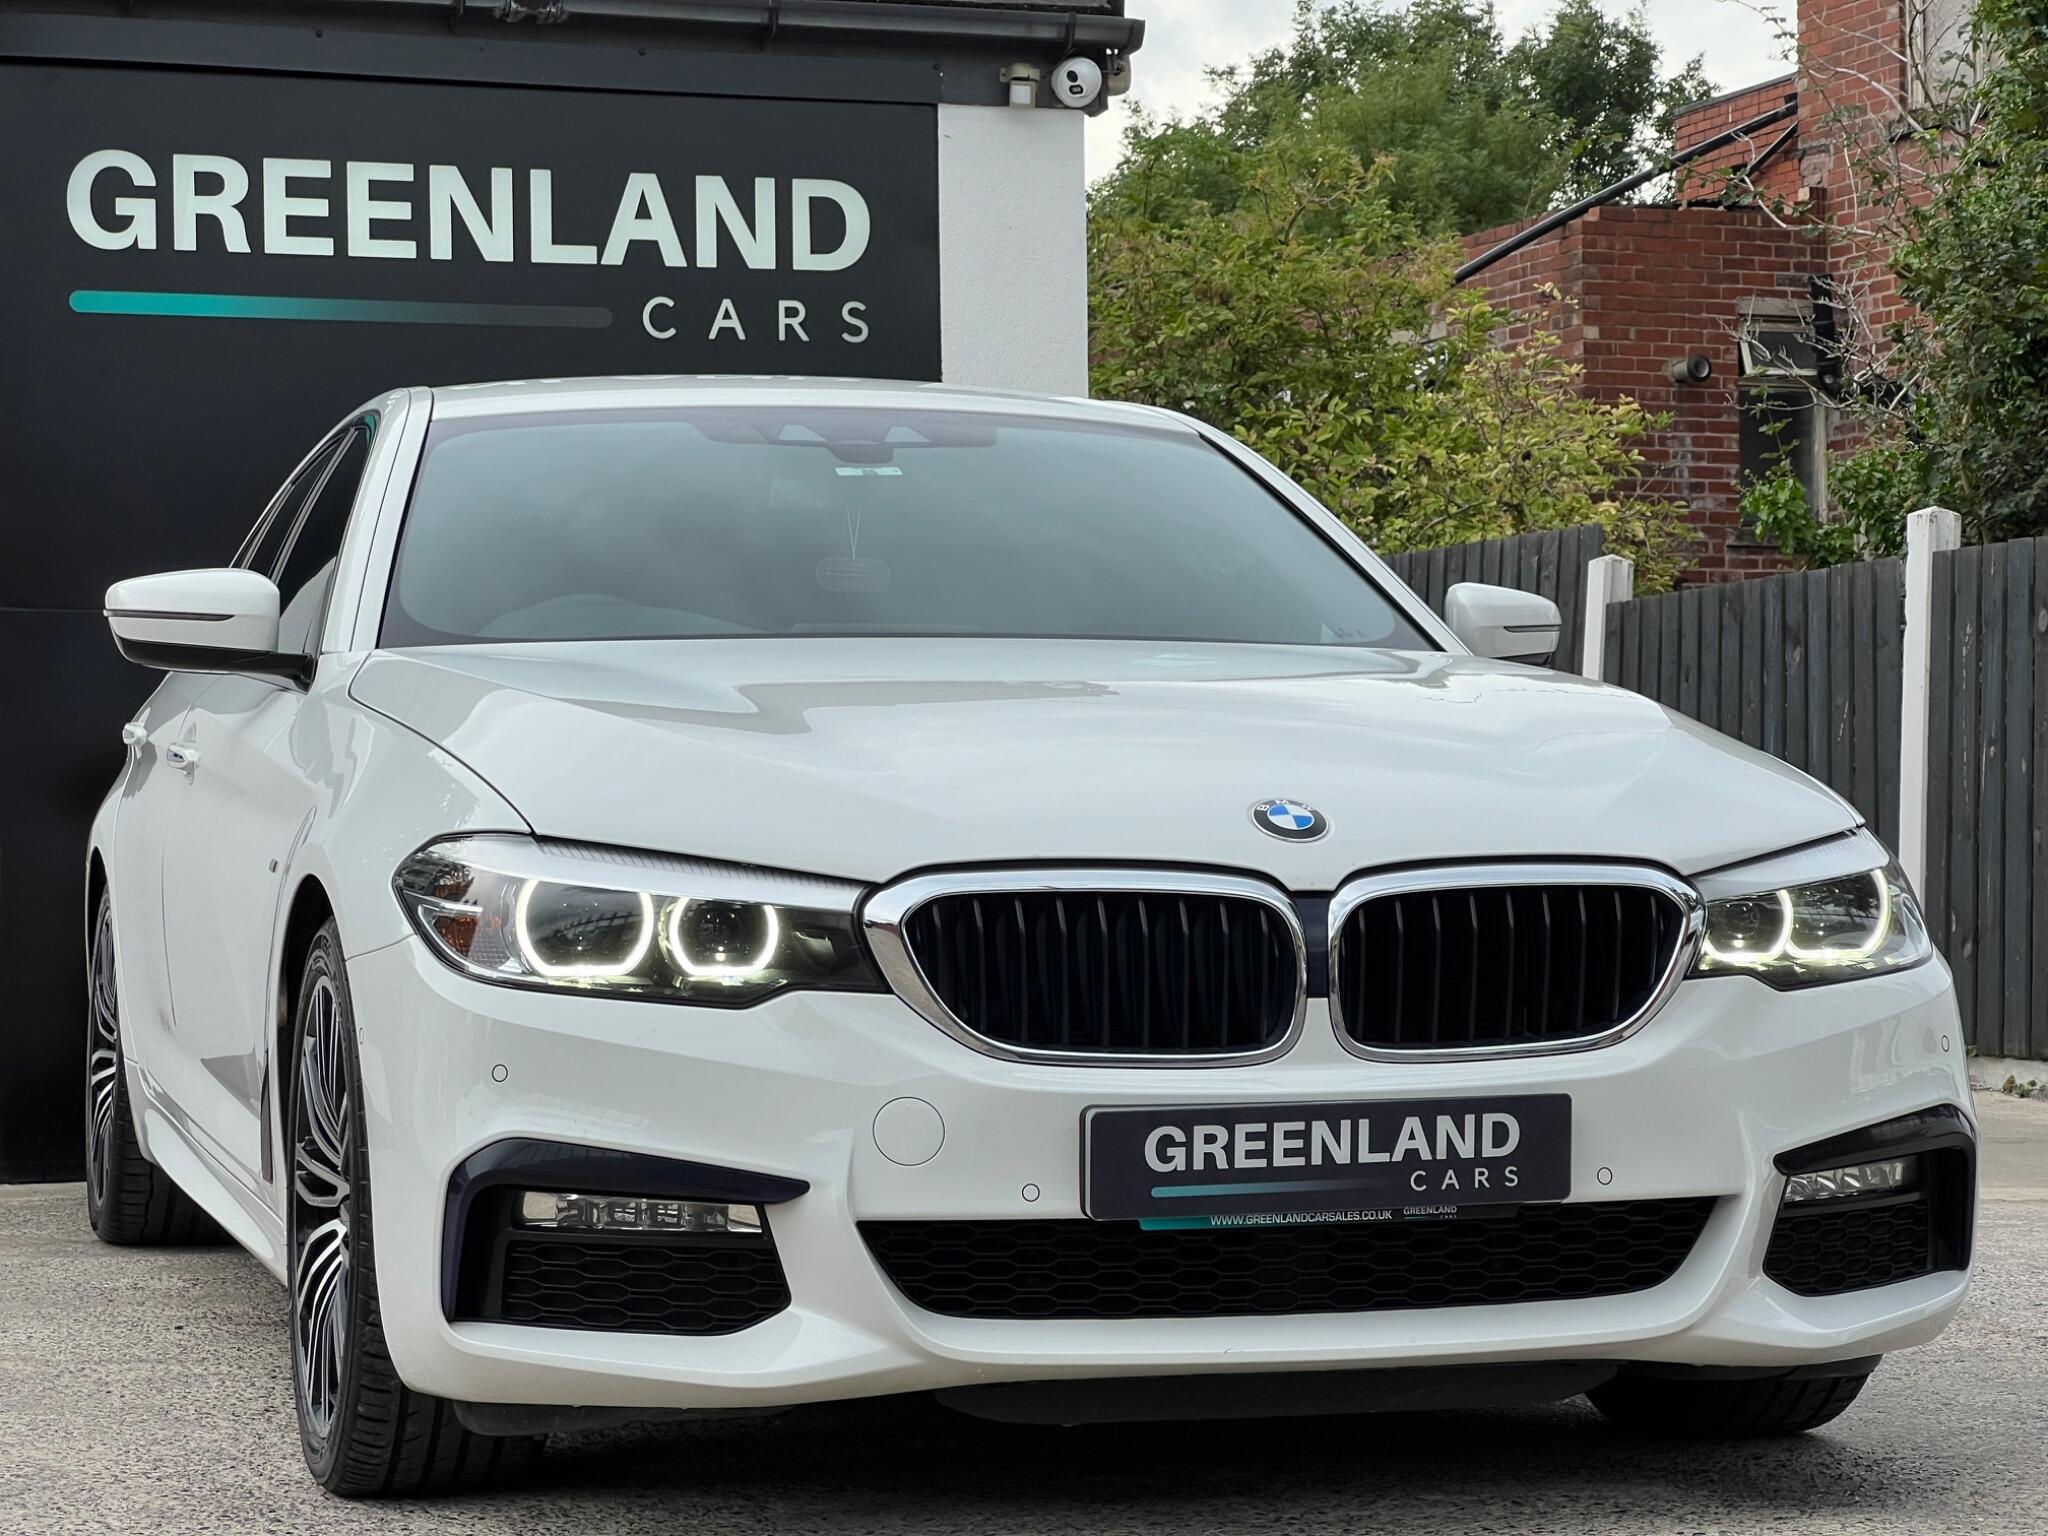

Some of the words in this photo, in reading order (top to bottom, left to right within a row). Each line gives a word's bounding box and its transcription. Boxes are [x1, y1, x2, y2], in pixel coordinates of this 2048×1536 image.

[66, 149, 871, 271] GREENLAND
[642, 296, 870, 343] CARS
[1144, 1112, 1521, 1173] GREENLAND
[1409, 1165, 1520, 1192] CARS
[1210, 1210, 1393, 1226] WWW.GREENLANDCARSALES.CO.UK
[1403, 1205, 1458, 1215] GREENLAND
